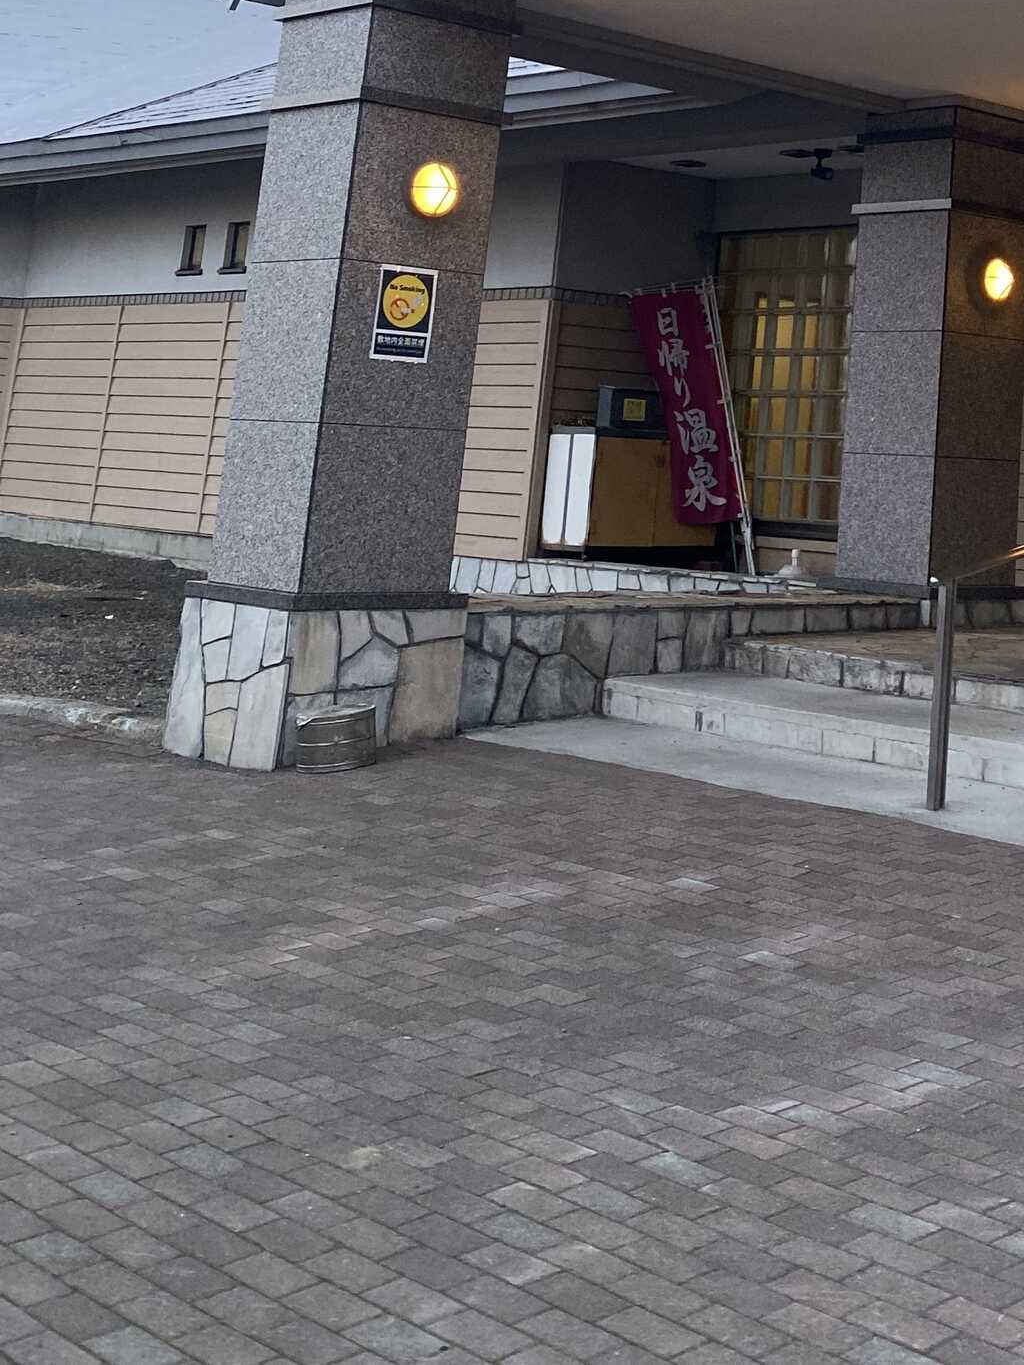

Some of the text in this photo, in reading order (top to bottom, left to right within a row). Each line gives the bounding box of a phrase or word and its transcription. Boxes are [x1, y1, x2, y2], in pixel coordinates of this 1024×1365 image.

[656, 307, 727, 512] 日帰り温泉
